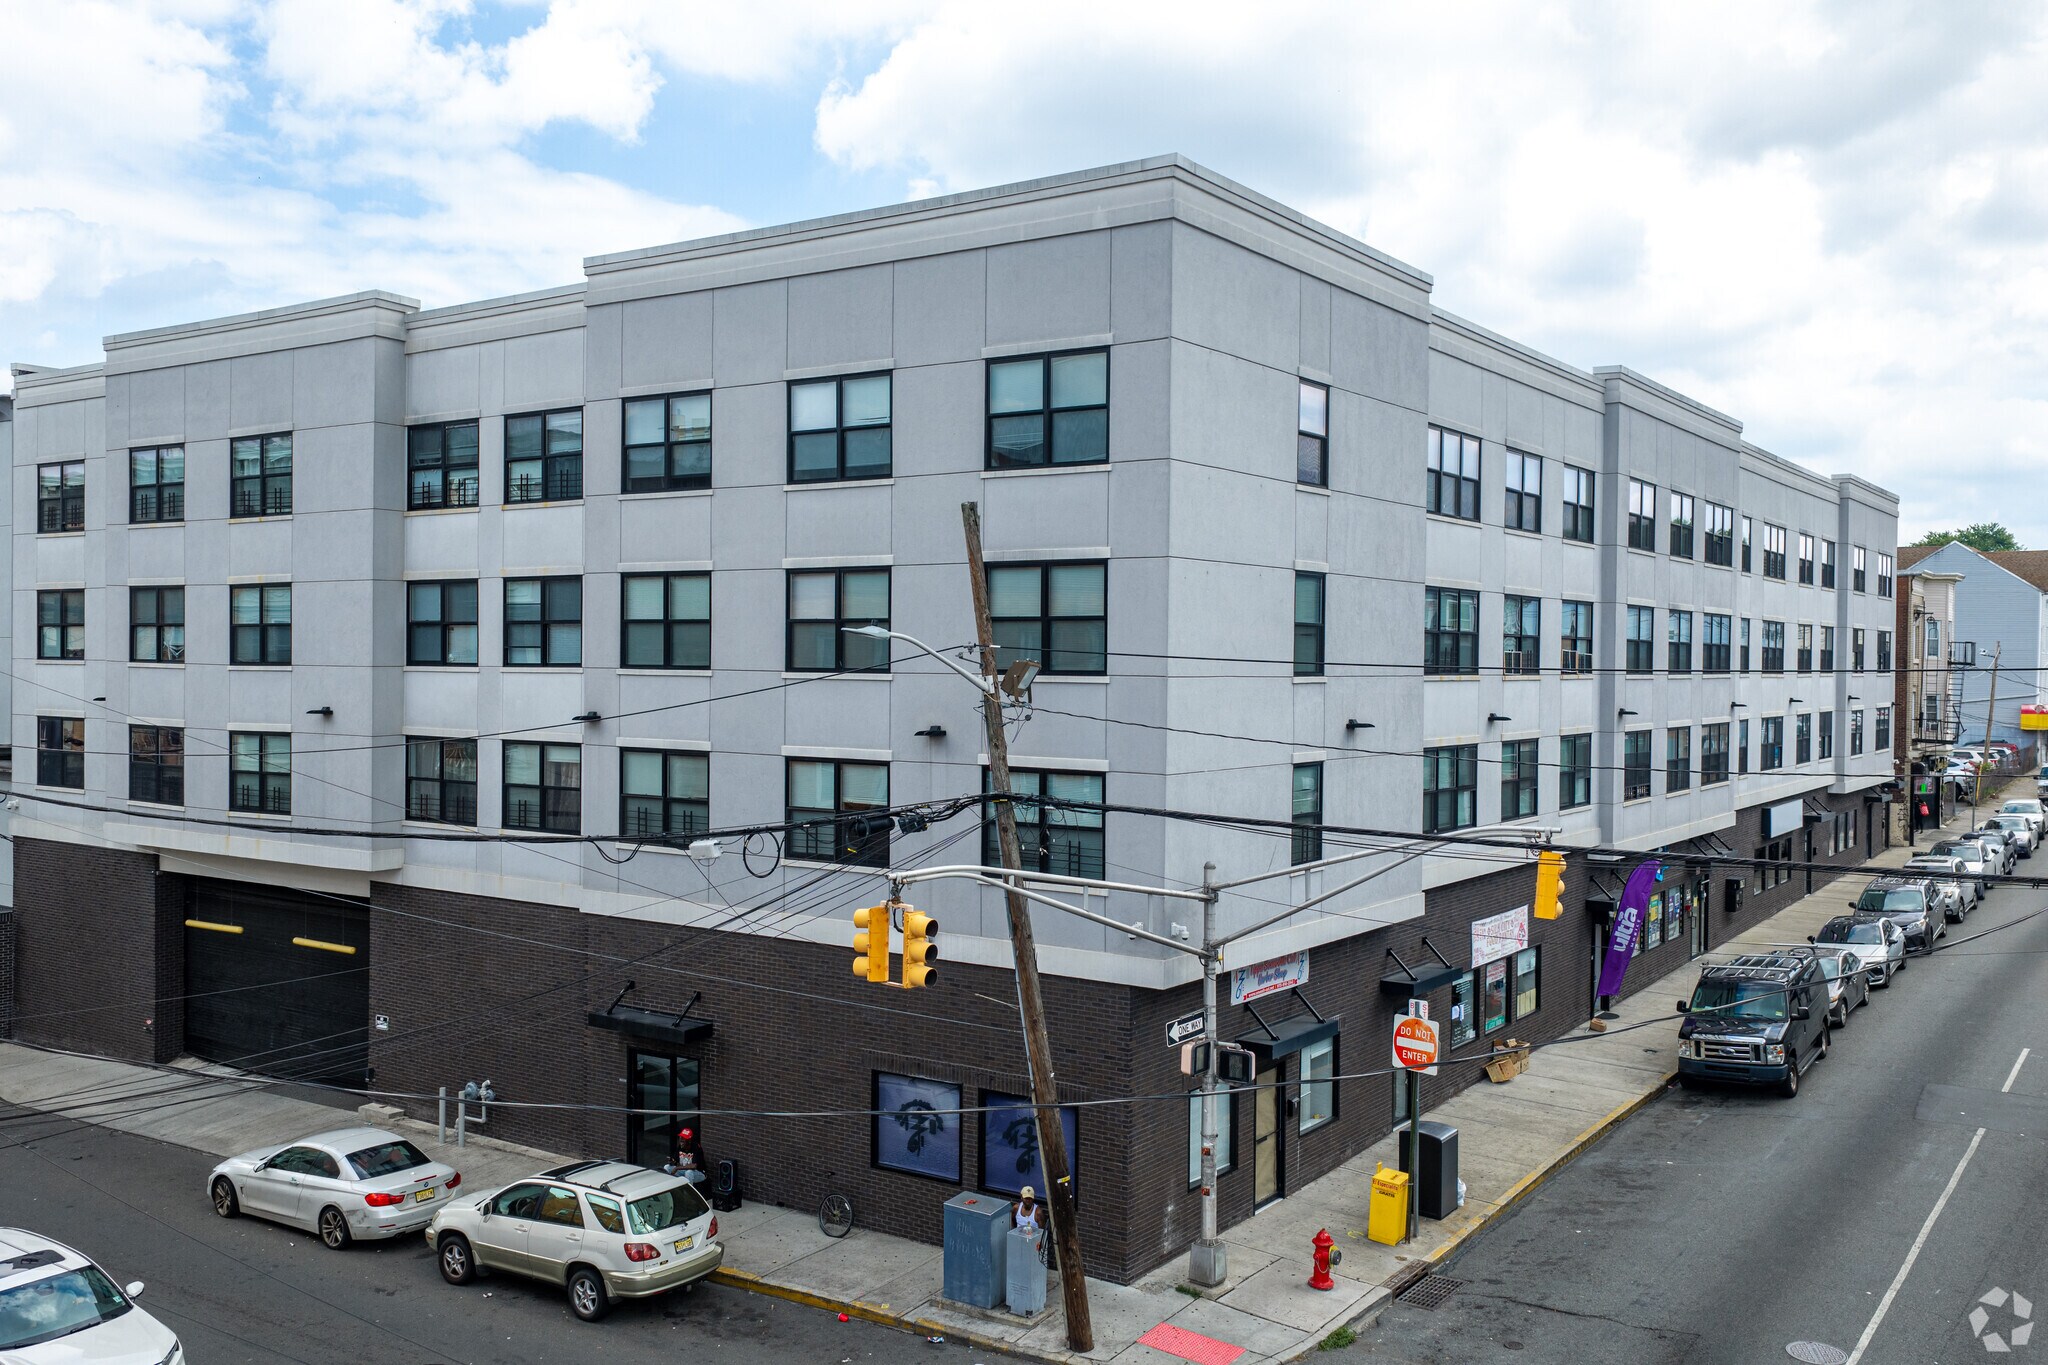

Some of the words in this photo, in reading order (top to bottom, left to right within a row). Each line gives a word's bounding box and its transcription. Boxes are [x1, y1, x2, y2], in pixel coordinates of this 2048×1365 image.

[1613, 907, 1638, 952] ultra
[1178, 1023, 1190, 1035] ONE
[1191, 1019, 1202, 1030] WAY
[1400, 1026, 1412, 1036] DO
[1415, 1029, 1432, 1040] NOT
[1402, 1050, 1427, 1062] ENTER
